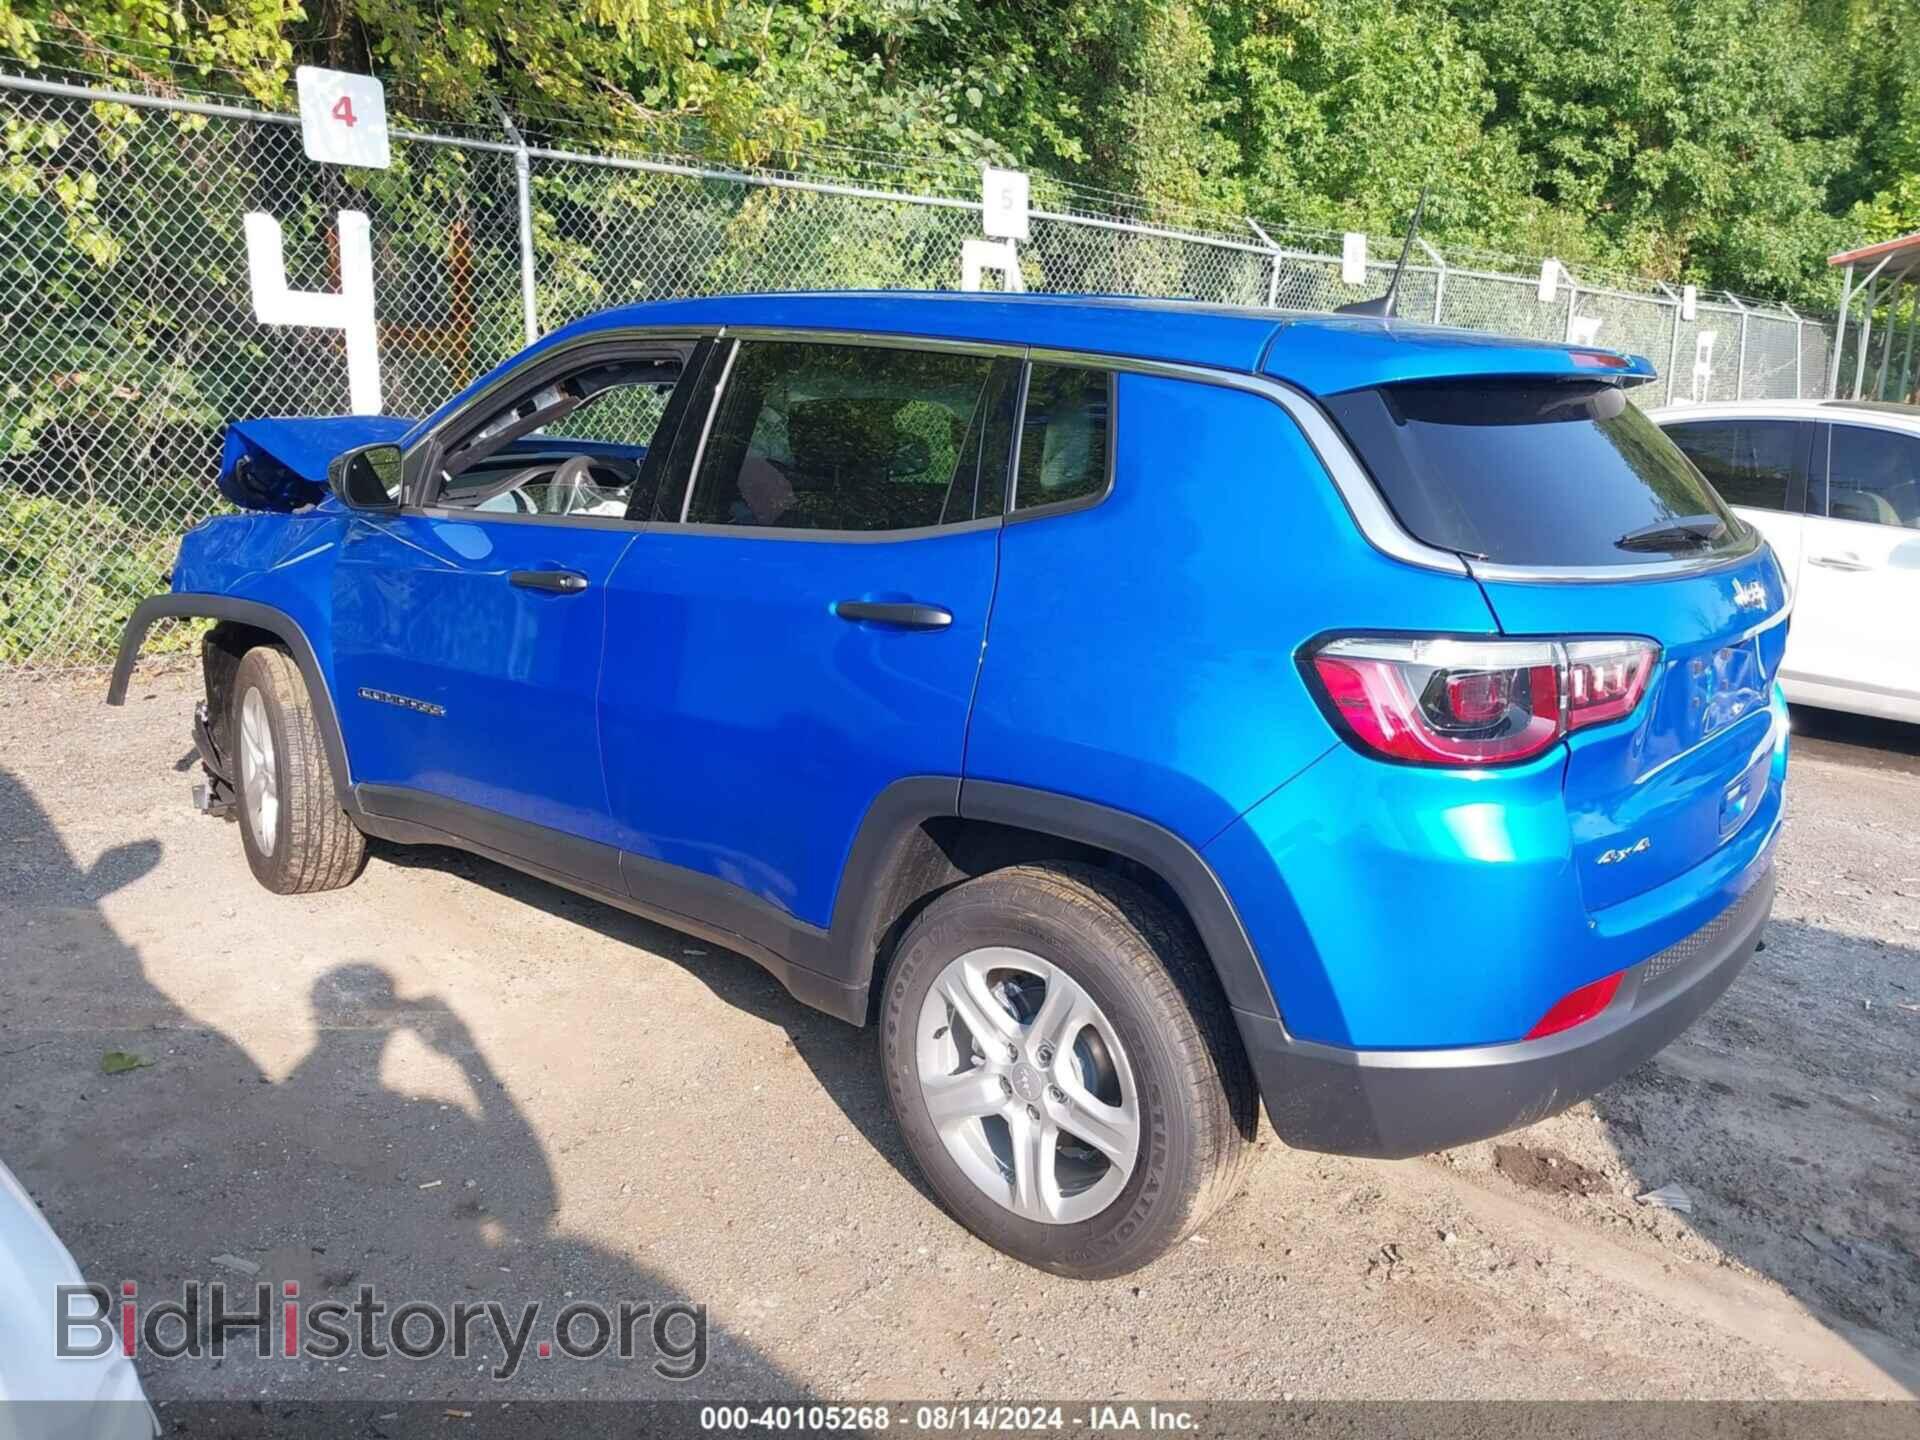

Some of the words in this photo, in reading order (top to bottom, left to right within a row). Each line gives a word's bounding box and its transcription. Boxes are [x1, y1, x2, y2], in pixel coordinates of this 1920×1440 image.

[332, 96, 357, 127] 4
[1001, 188, 1014, 210] 5
[244, 210, 382, 415] 4
